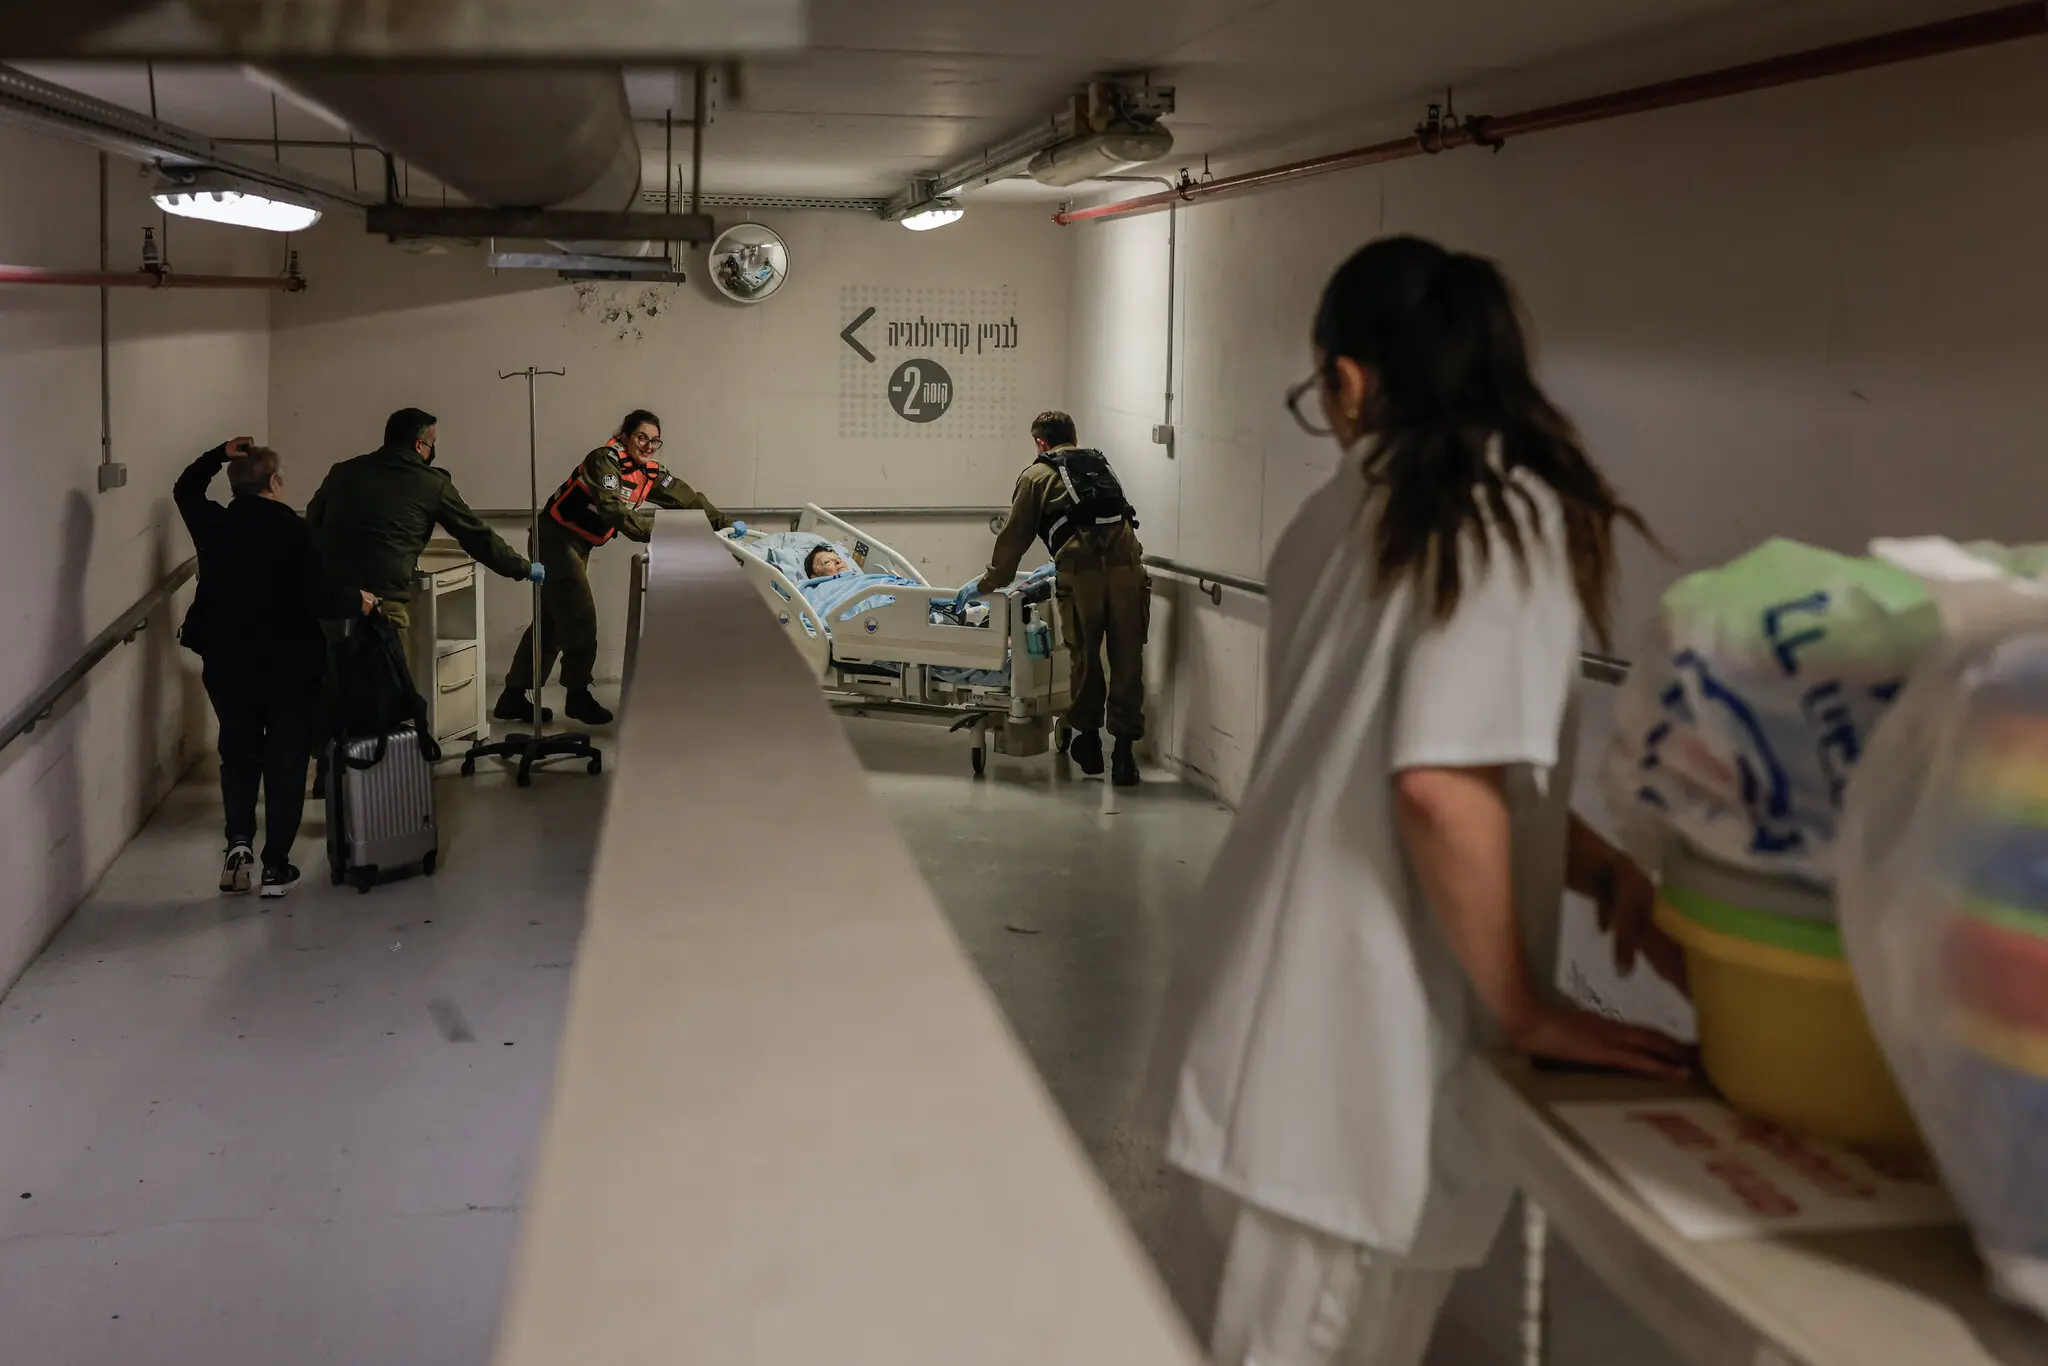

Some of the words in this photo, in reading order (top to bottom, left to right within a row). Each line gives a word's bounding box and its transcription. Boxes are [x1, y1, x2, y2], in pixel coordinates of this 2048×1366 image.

[888, 315, 970, 355] קרדיולוגיה
[978, 316, 1018, 355] לבניין
[923, 382, 949, 410] קומה
